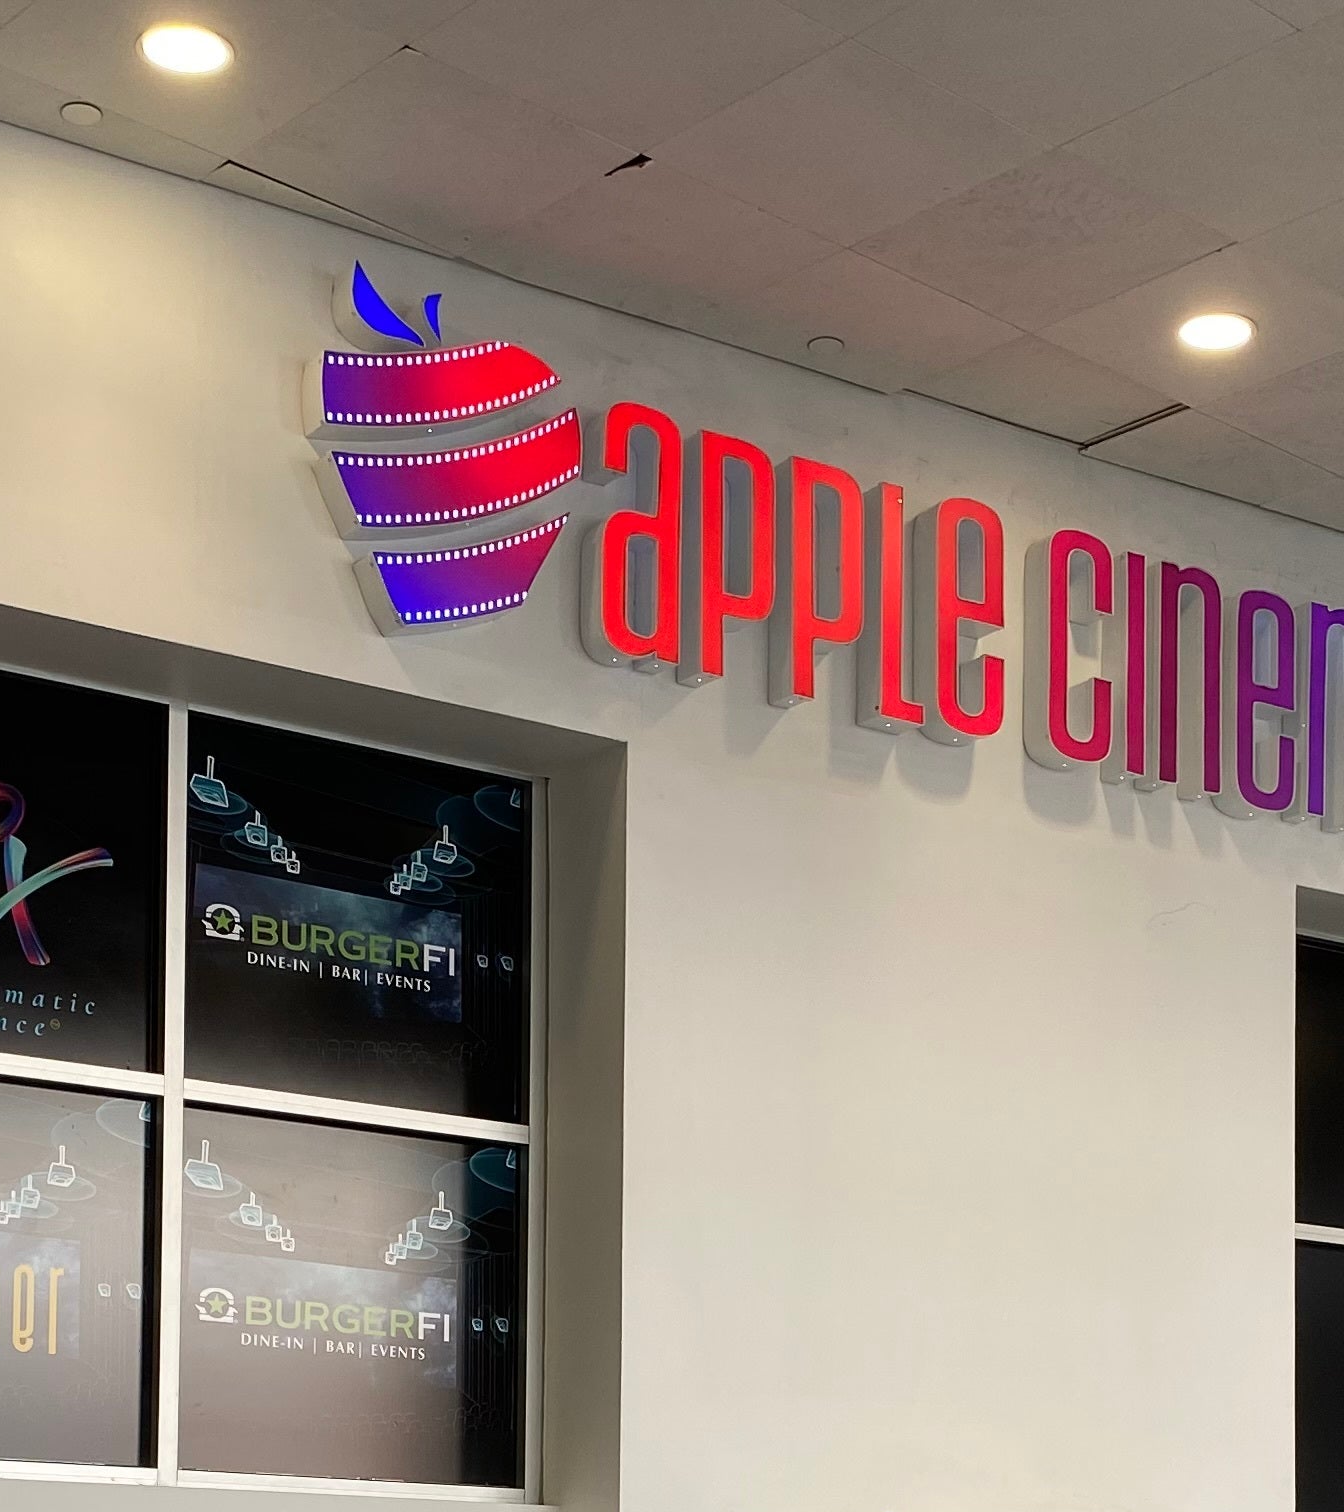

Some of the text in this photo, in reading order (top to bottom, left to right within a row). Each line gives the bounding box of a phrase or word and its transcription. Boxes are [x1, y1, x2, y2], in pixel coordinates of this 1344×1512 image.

[251, 914, 455, 977] BURGERFI
[247, 951, 310, 973] DINE-IN
[376, 972, 431, 992] EVENTS
[245, 1295, 450, 1343] BURGERFI
[240, 1332, 304, 1351] DINE-IN
[371, 1344, 426, 1361] EVENTS
